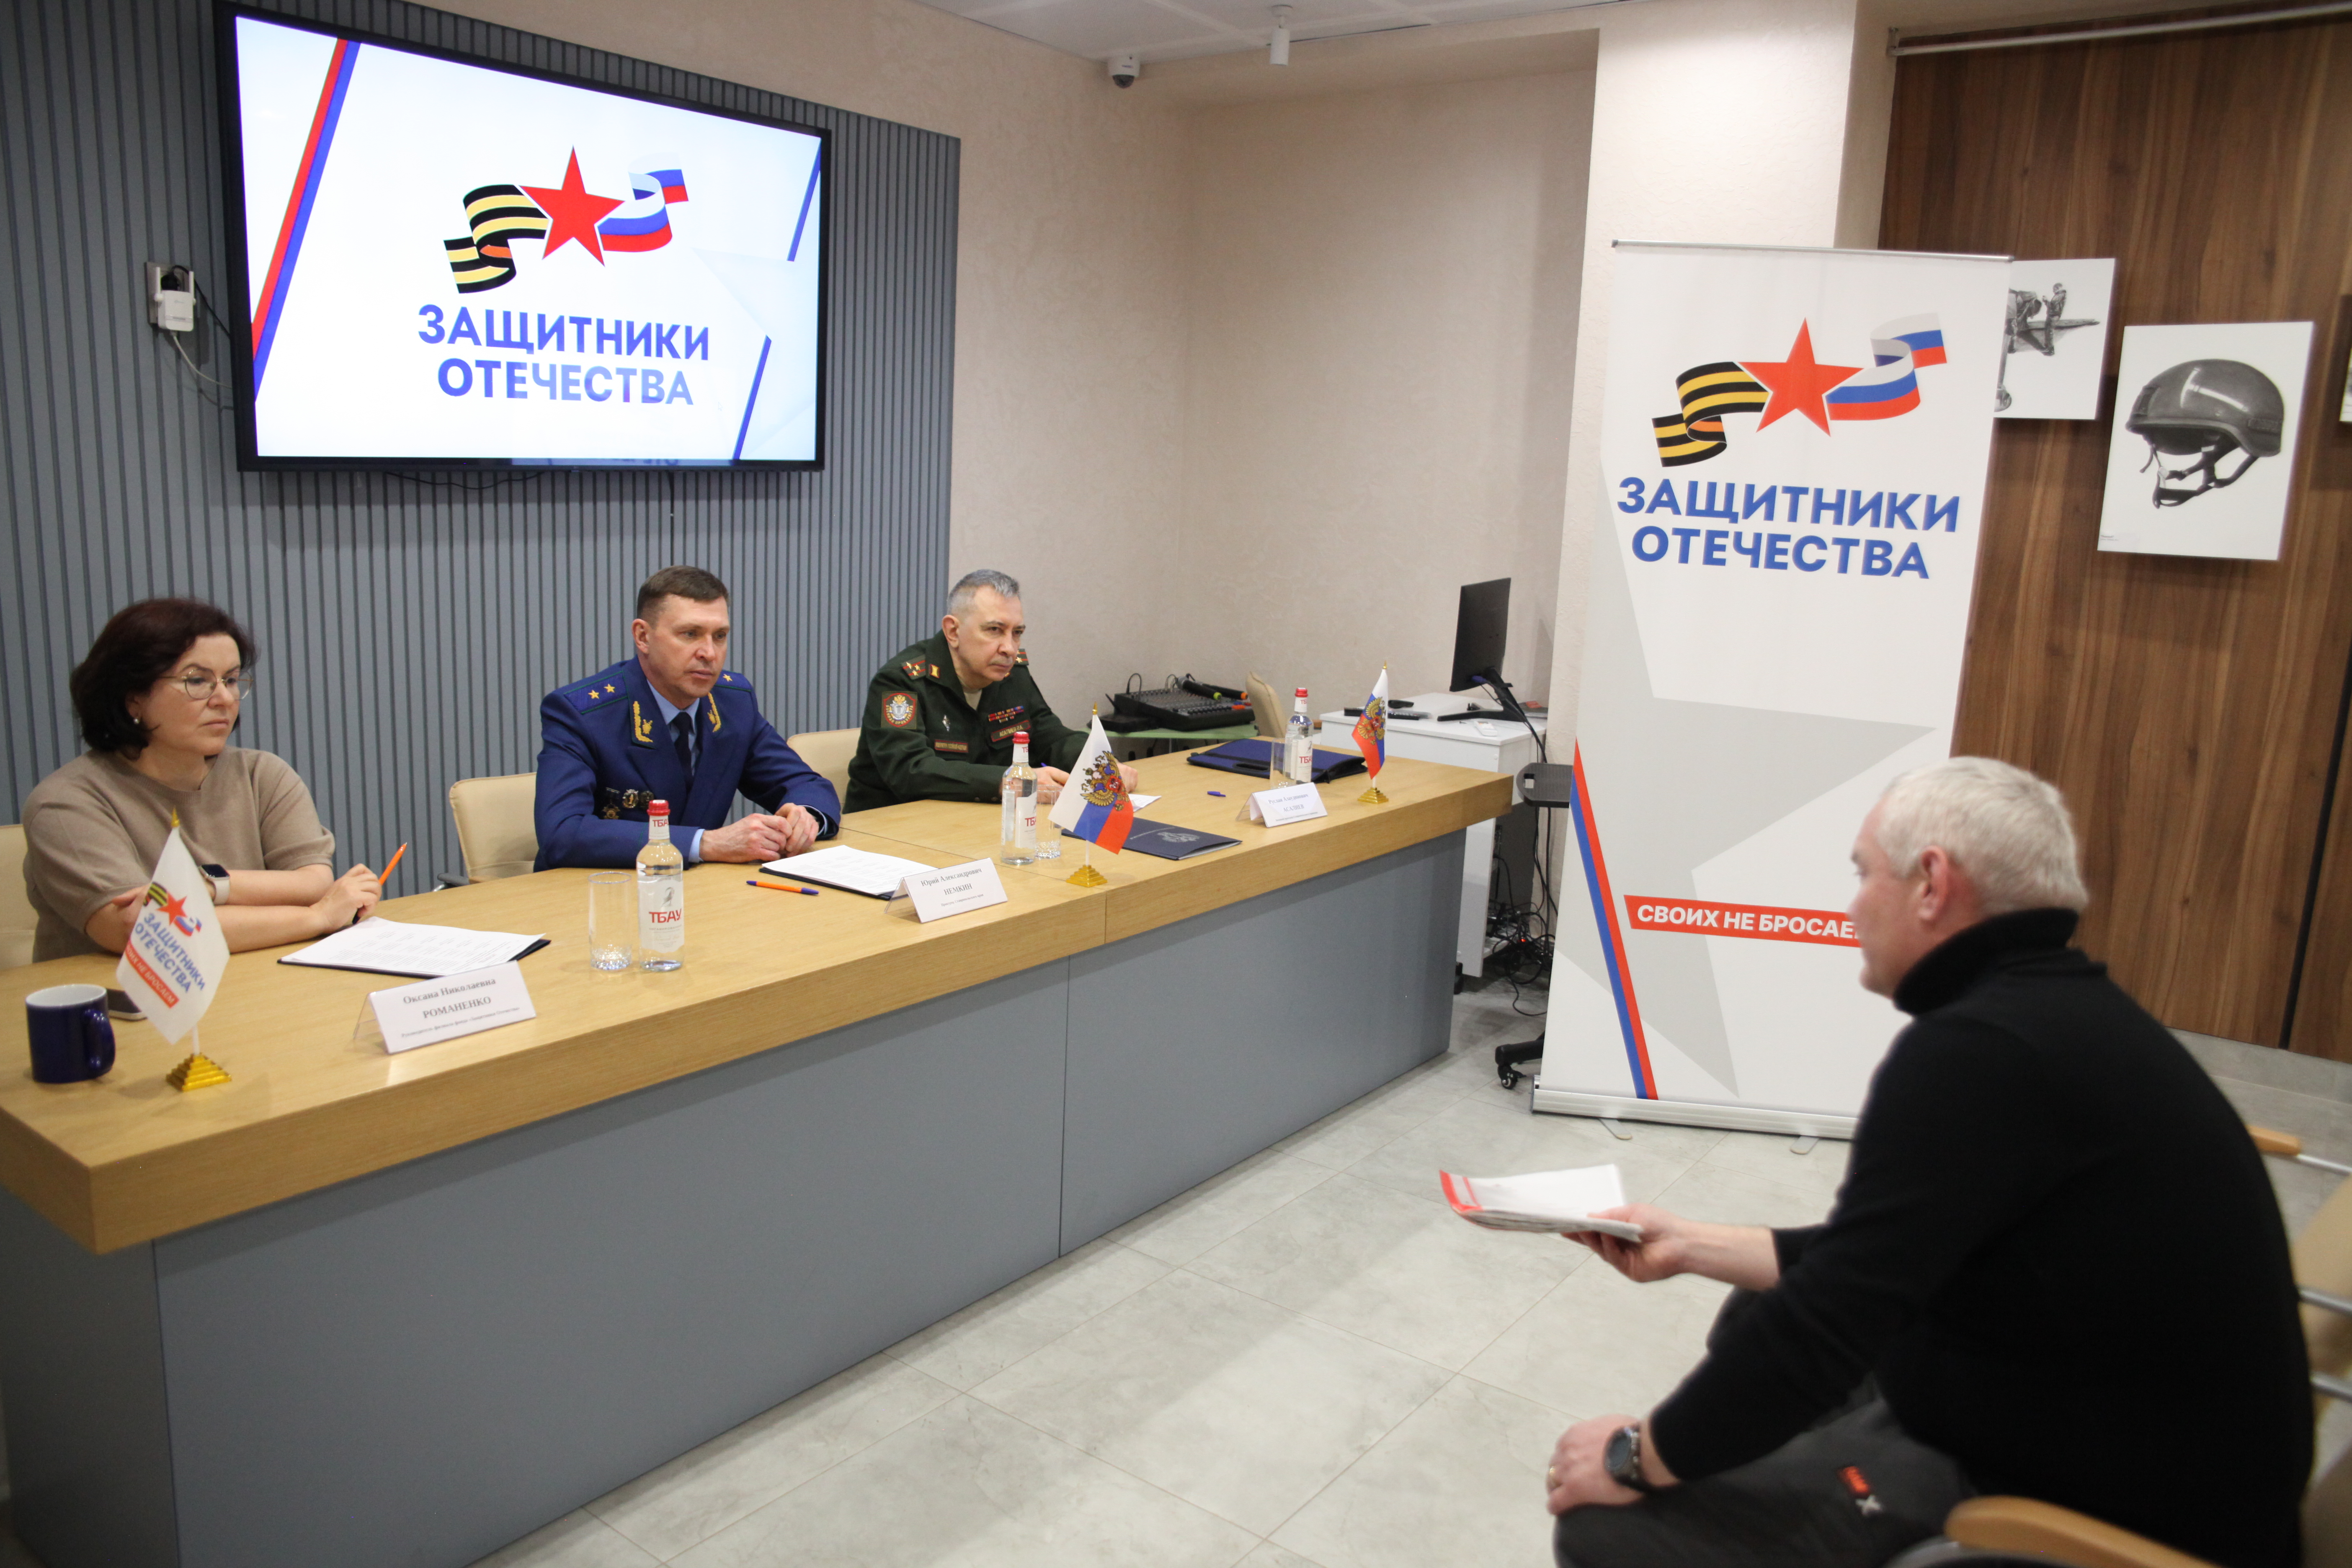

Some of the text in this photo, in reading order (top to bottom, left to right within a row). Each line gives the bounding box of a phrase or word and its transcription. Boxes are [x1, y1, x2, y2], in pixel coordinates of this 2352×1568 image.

[418, 304, 709, 361] ЗАЩИТНИКИ
[438, 358, 694, 405] ОТЕЧЕСТВА
[1617, 477, 1960, 532] ЗАЩИТНИКИ
[1632, 526, 1929, 579] ОТЕЧЕСТВА
[921, 868, 982, 886] Юрий Александрович
[944, 883, 972, 895] НЕМКИН
[649, 908, 682, 923] ТБАУ
[1637, 905, 1859, 939] СВОИХ НЕ БРОСАЕ
[135, 923, 191, 993] ОТЕЧЕСТВА
[144, 913, 205, 991] ЗАЩИТНИКИ
[403, 979, 496, 1004] Оксана Николаевна
[423, 996, 491, 1019] РОМАНЕНКО
